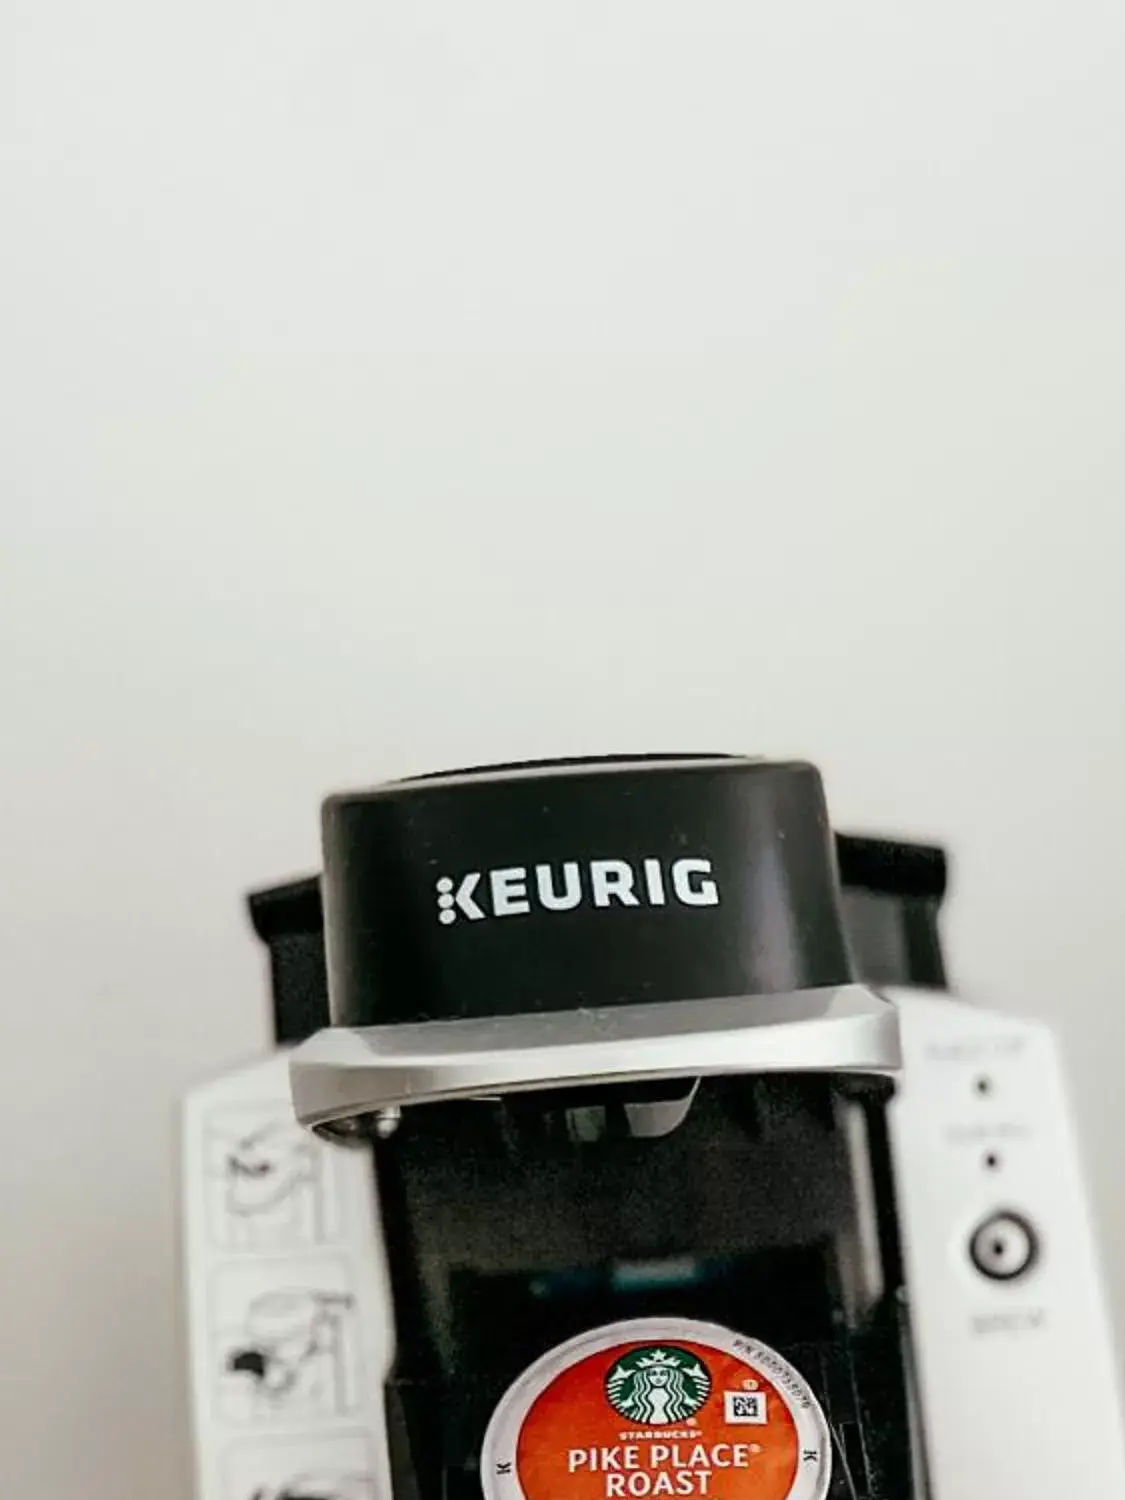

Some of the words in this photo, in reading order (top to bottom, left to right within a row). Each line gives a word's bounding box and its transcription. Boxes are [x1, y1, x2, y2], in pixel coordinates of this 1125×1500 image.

[436, 858, 720, 925] KEURIG
[568, 1446, 640, 1472] PIKE
[606, 1470, 711, 1497] ROAST
